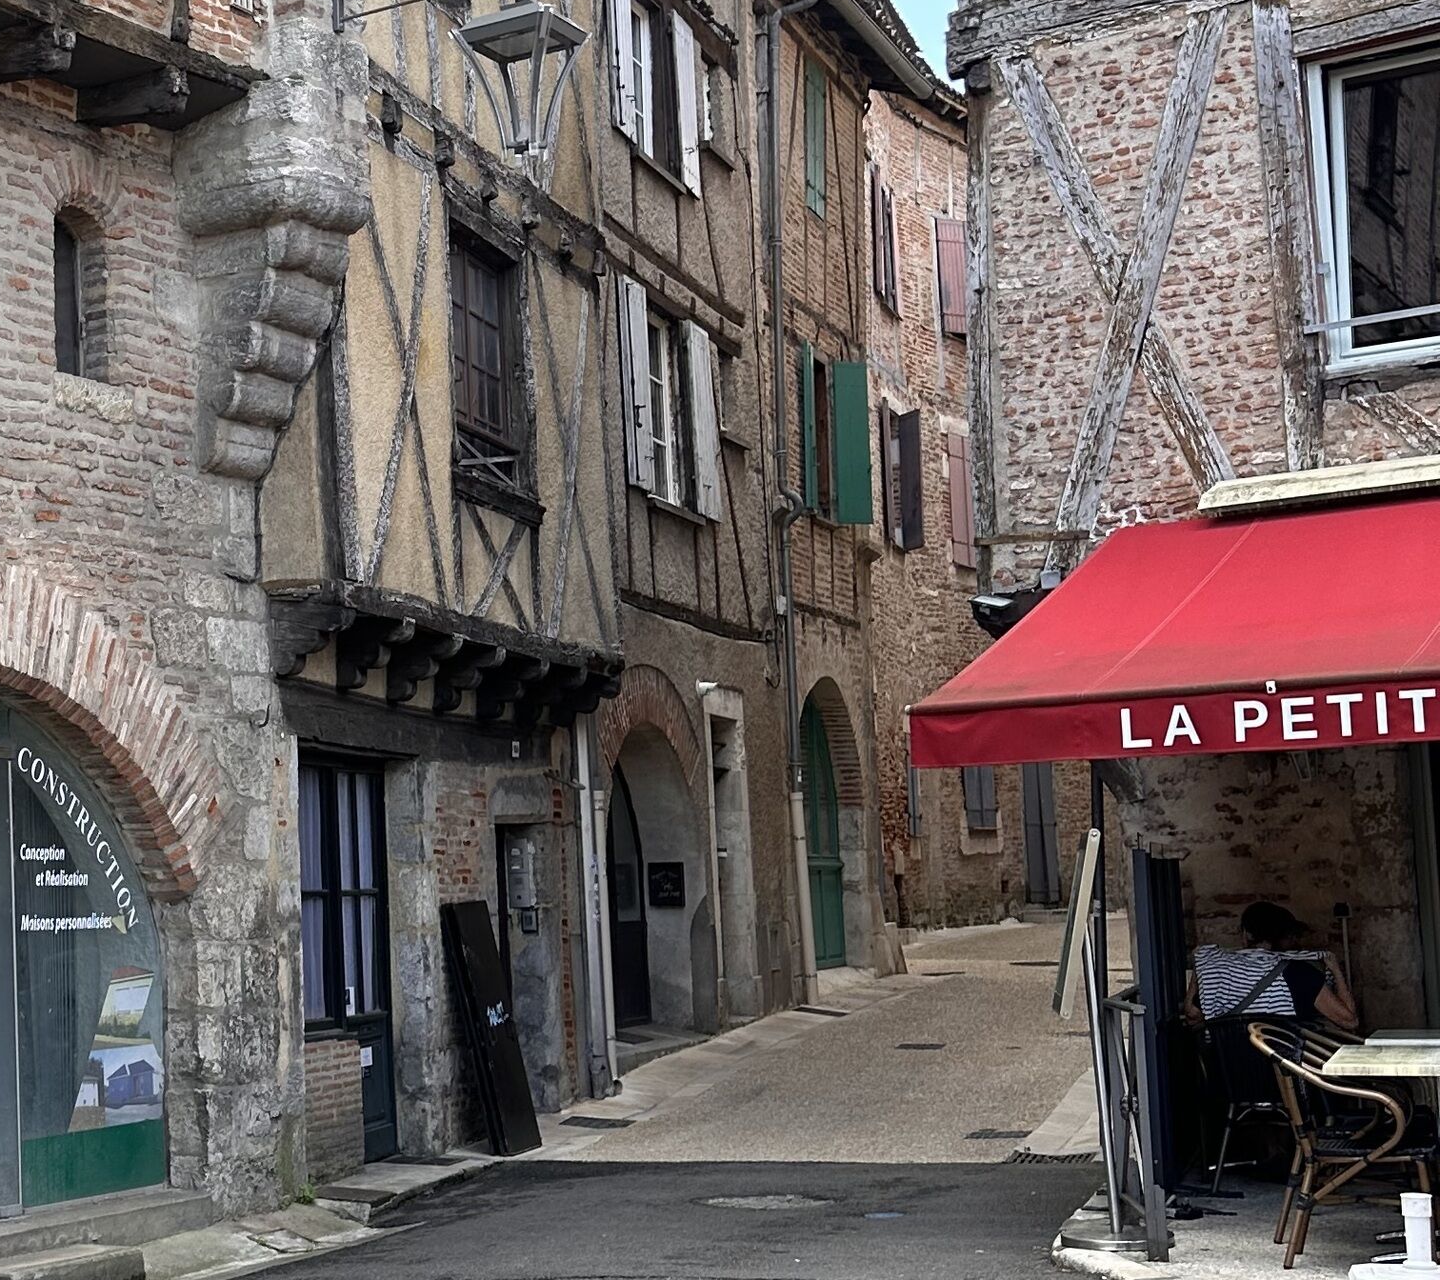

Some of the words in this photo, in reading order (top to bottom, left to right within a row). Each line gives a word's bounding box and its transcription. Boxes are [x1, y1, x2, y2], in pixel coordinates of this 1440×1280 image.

[1120, 704, 1201, 749] LA
[1233, 688, 1436, 743] PETIT
[17, 747, 140, 929] CONSTRUCTION
[20, 843, 65, 865] Conception
[35, 871, 45, 887] et
[45, 869, 89, 886] Réalisation
[20, 913, 55, 931] Maisons
[55, 912, 112, 934] personnalisées
